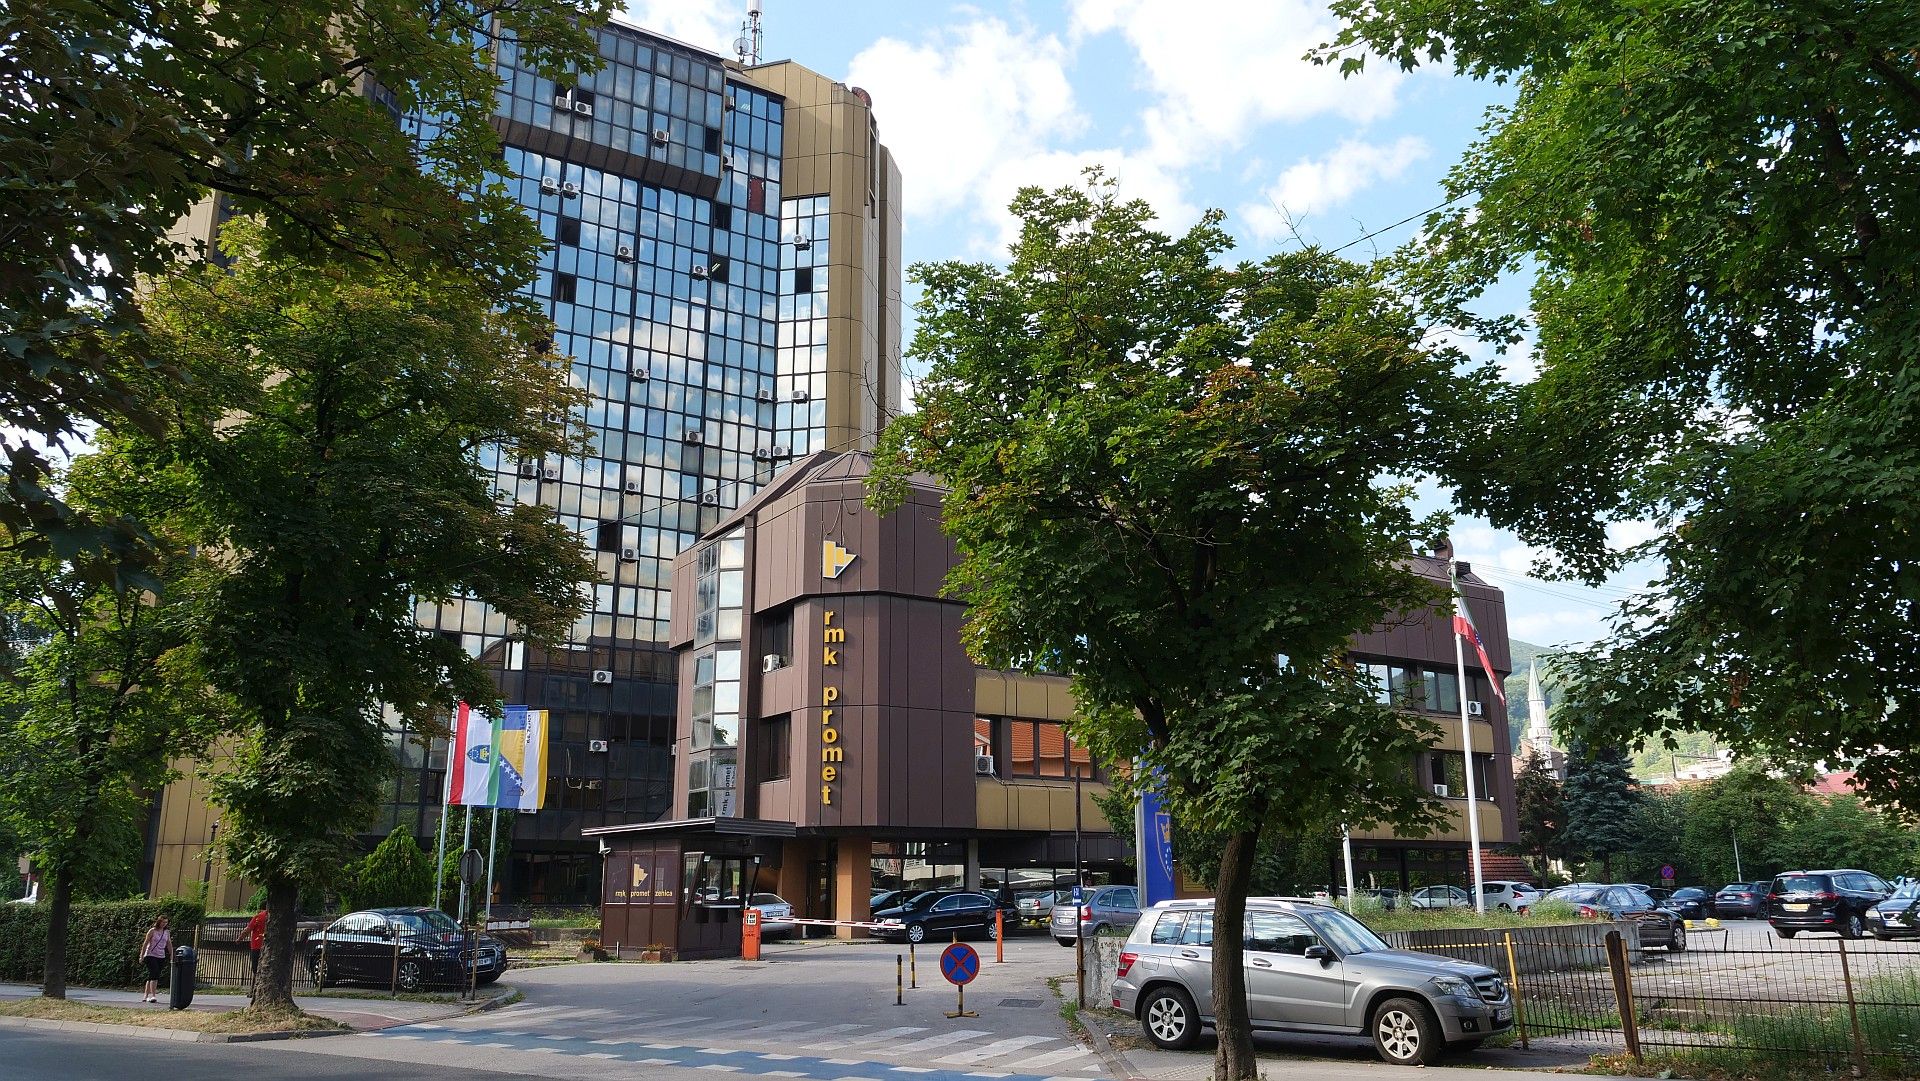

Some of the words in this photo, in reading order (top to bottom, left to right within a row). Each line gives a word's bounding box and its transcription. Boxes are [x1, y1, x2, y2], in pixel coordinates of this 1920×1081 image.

[823, 610, 845, 665] rmk
[821, 686, 843, 805] promet
[721, 798, 729, 815] rmk
[615, 889, 627, 897] rmk
[630, 889, 650, 899] promet
[654, 889, 673, 897] zenica
